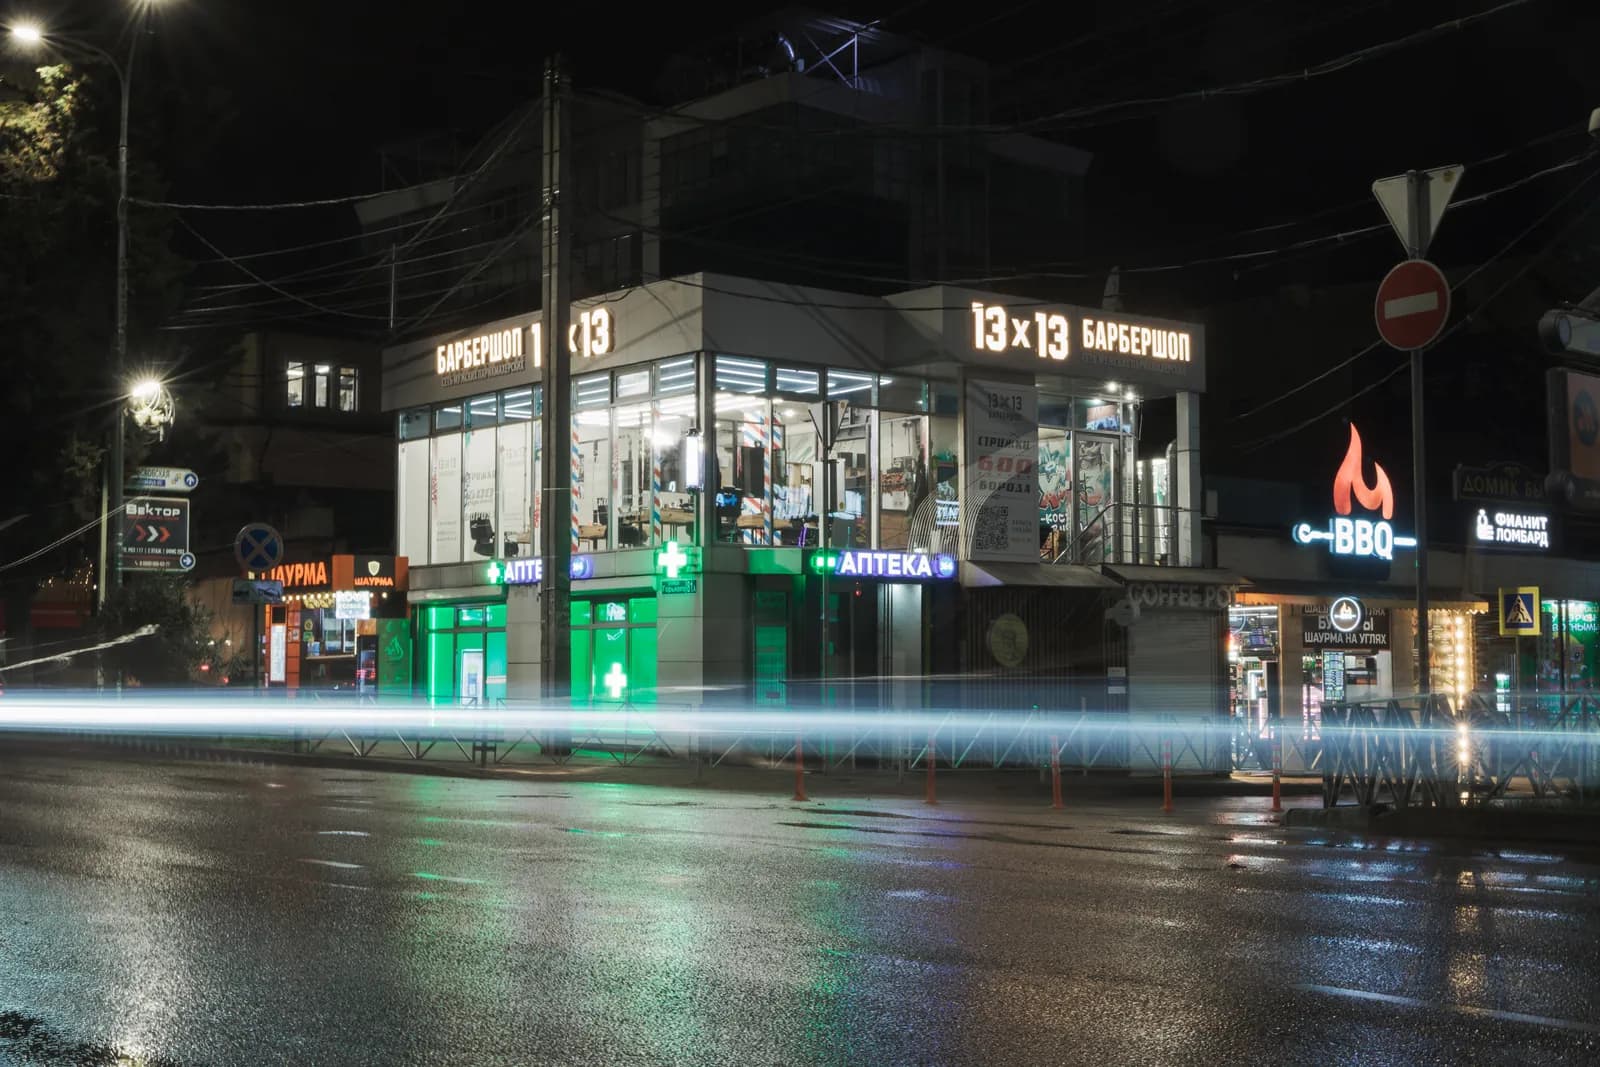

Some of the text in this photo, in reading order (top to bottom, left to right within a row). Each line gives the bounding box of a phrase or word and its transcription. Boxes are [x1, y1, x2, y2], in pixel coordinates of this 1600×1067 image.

[437, 328, 522, 374] БАРБЕРШОП
[1083, 319, 1191, 362] БАРБЕРШОП
[1462, 475, 1519, 496] ДОМИК
[1495, 512, 1548, 531] ФИАНИТ
[1335, 518, 1392, 560] BBQ
[1495, 527, 1549, 548] ЛОМБАРД
[504, 559, 542, 582] АПТЕ
[839, 553, 932, 577] АПТЕКА
[355, 576, 393, 586] ШАУРМА
[1128, 583, 1201, 608] COFFEE
[1304, 631, 1387, 645] ШАУРМА НА УГЛЯХ
